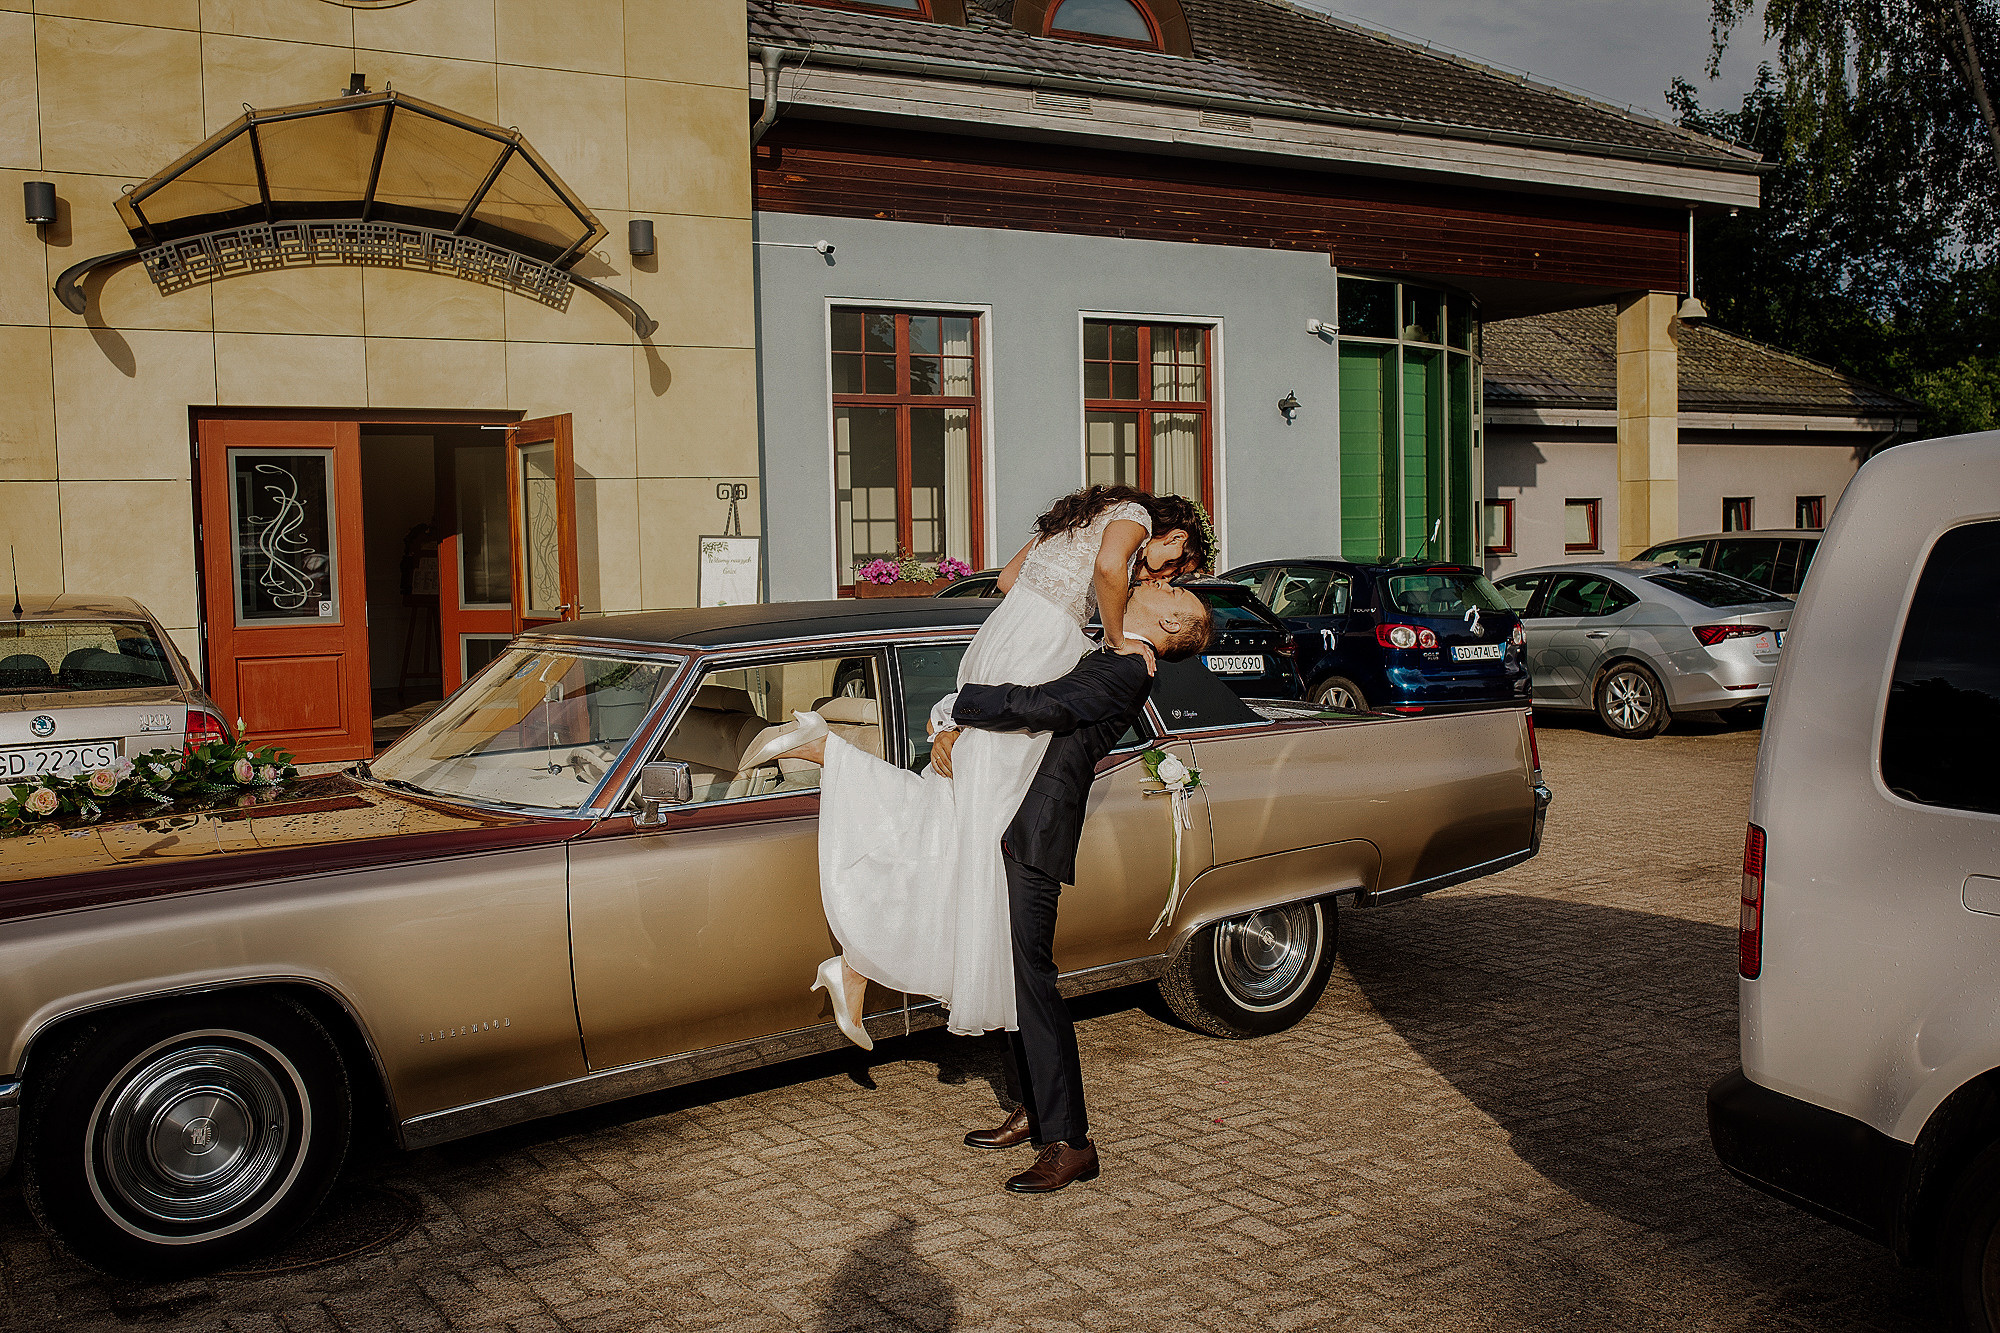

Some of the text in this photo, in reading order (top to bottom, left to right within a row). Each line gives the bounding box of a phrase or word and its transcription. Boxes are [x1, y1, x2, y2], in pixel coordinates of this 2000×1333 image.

[1457, 645, 1499, 660] GD 474LE
[1210, 656, 1261, 670] GD 9C690
[35, 746, 111, 772] 222CS
